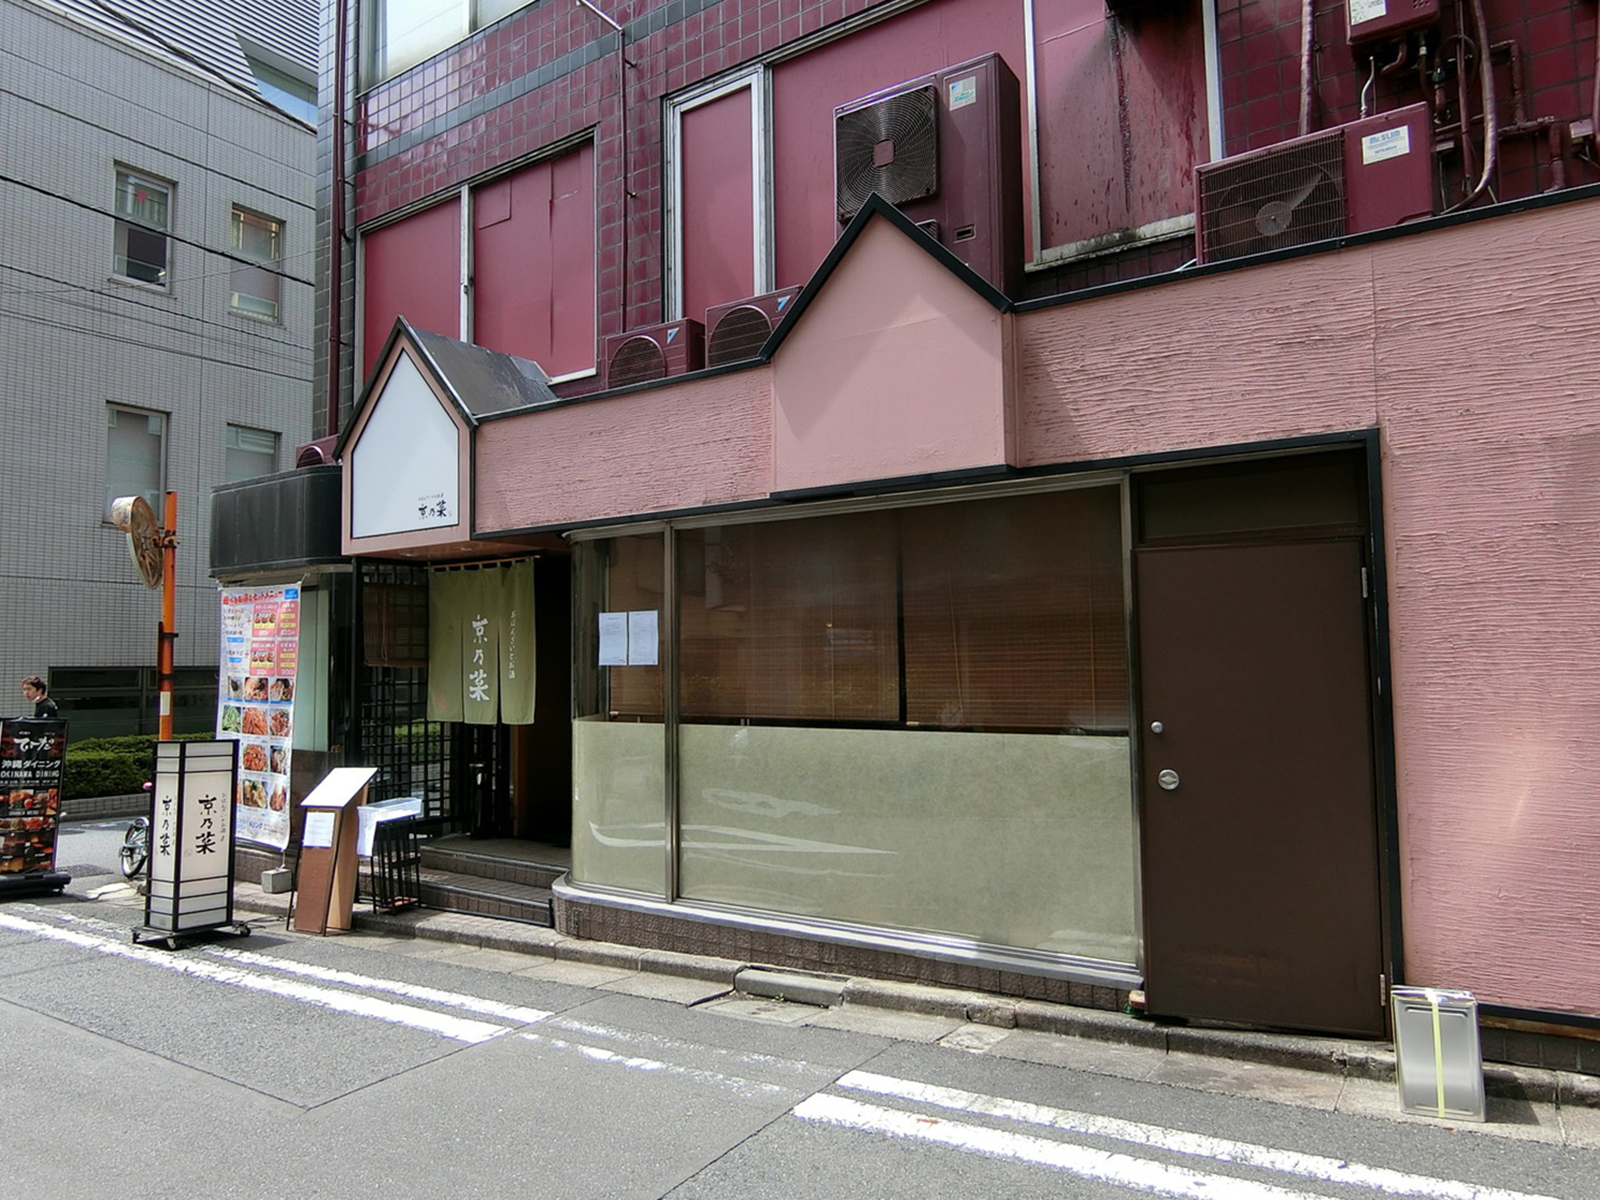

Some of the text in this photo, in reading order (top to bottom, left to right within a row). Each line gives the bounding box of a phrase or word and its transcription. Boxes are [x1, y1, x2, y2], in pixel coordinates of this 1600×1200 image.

[418, 500, 447, 520] 京乃菜
[469, 614, 490, 701] 京乃菜
[0, 770, 60, 778] OKINAWA DINING
[160, 794, 172, 856] 京乃菜
[196, 794, 217, 855] 京乃菜
